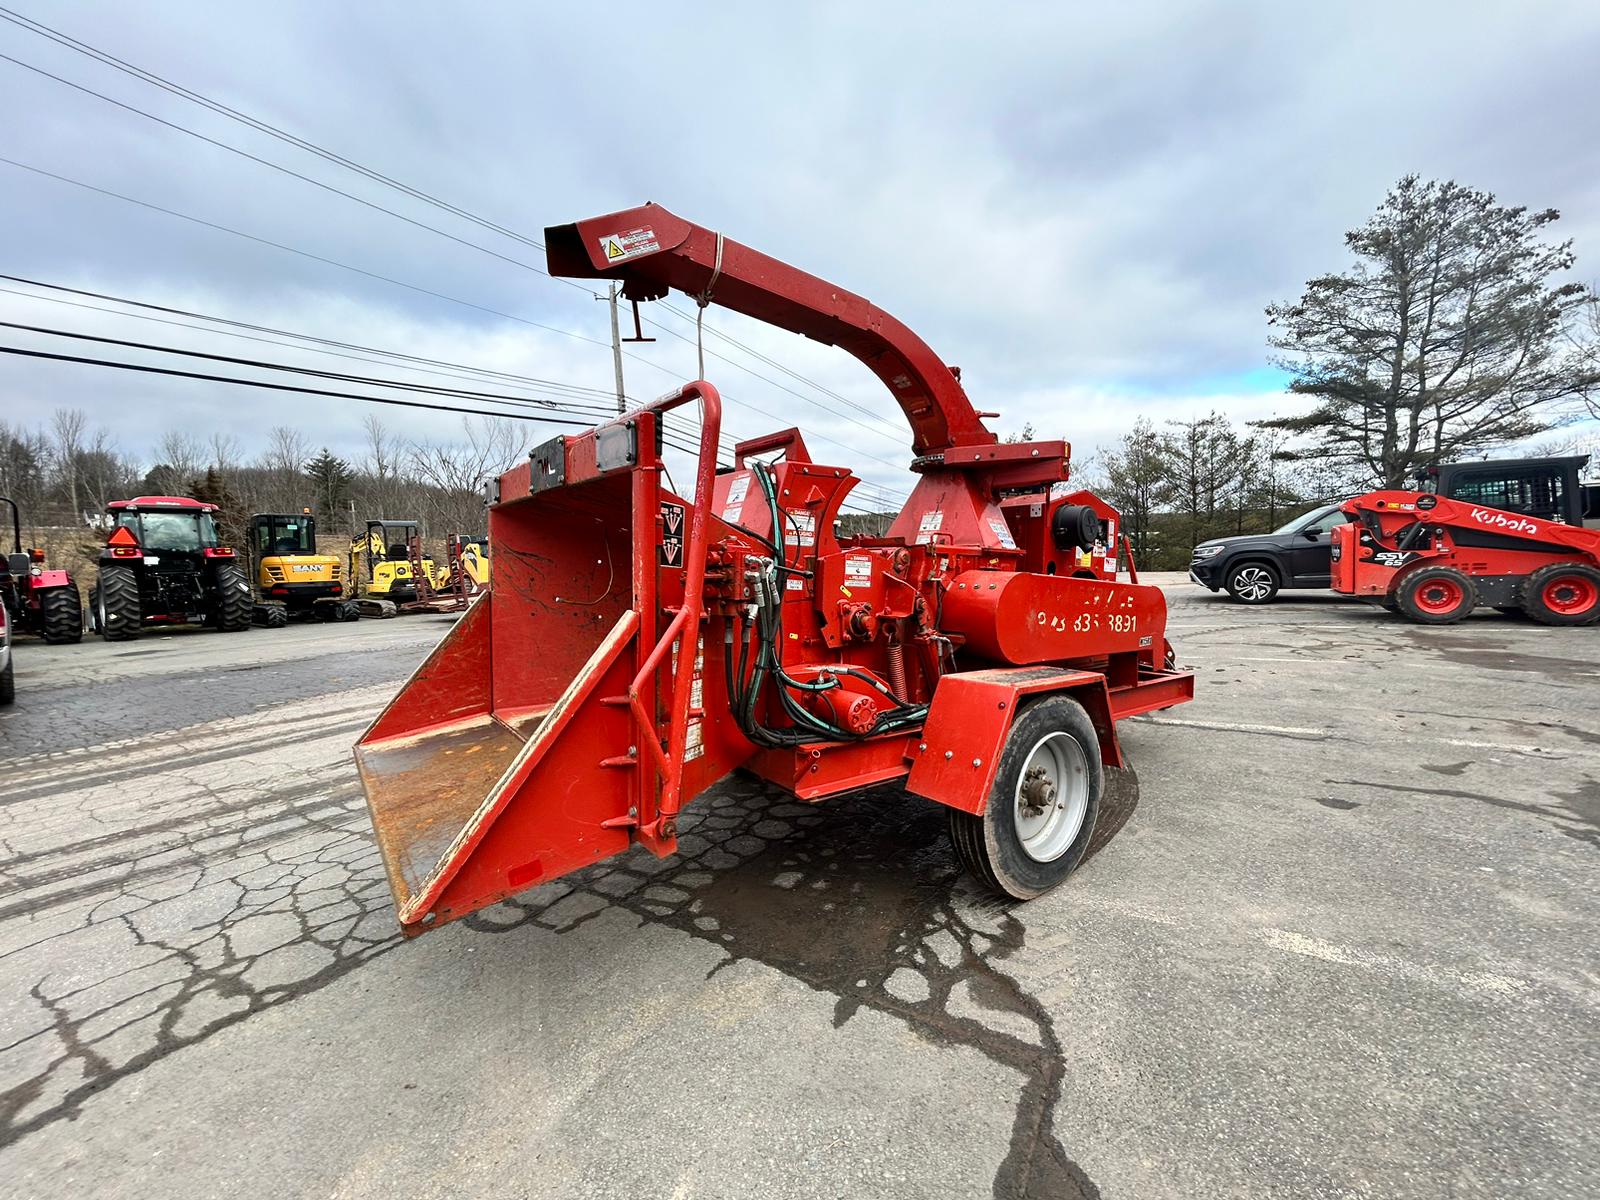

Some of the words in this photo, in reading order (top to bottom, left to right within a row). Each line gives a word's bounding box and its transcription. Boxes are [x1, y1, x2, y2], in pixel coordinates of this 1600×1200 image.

[1471, 508, 1537, 534] Kubota
[1374, 552, 1411, 560] SSV
[292, 564, 323, 572] SANY
